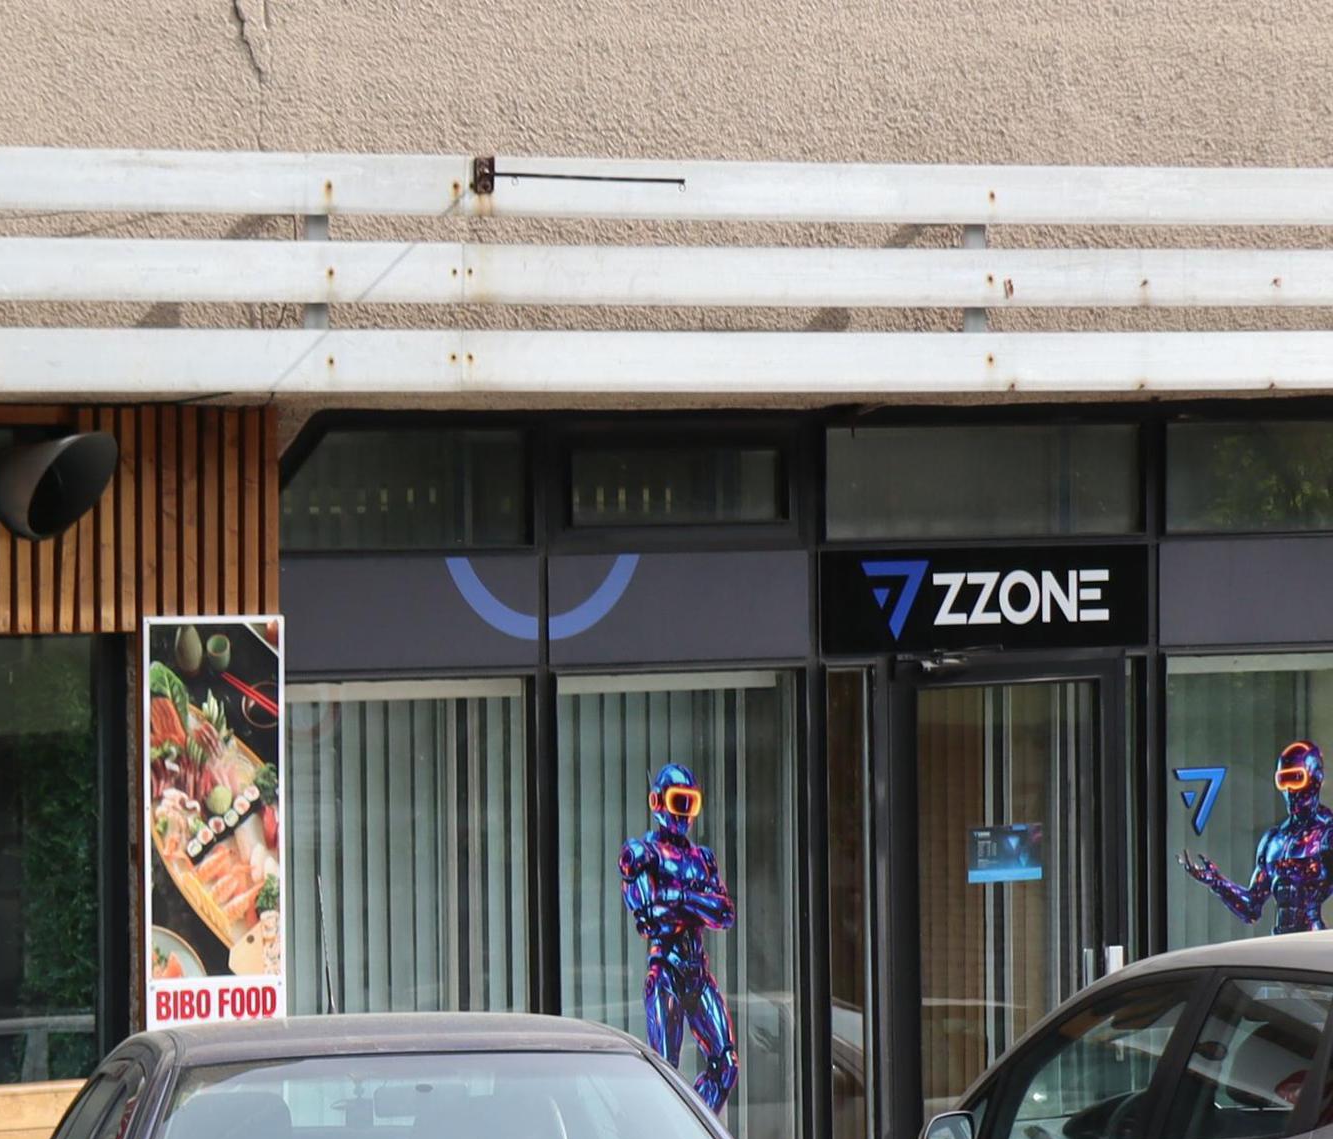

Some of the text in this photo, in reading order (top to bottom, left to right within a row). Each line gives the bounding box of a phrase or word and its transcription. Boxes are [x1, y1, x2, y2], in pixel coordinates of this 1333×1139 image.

[932, 569, 1110, 625] ZZONE
[155, 985, 278, 1022] BIBO FOOD
